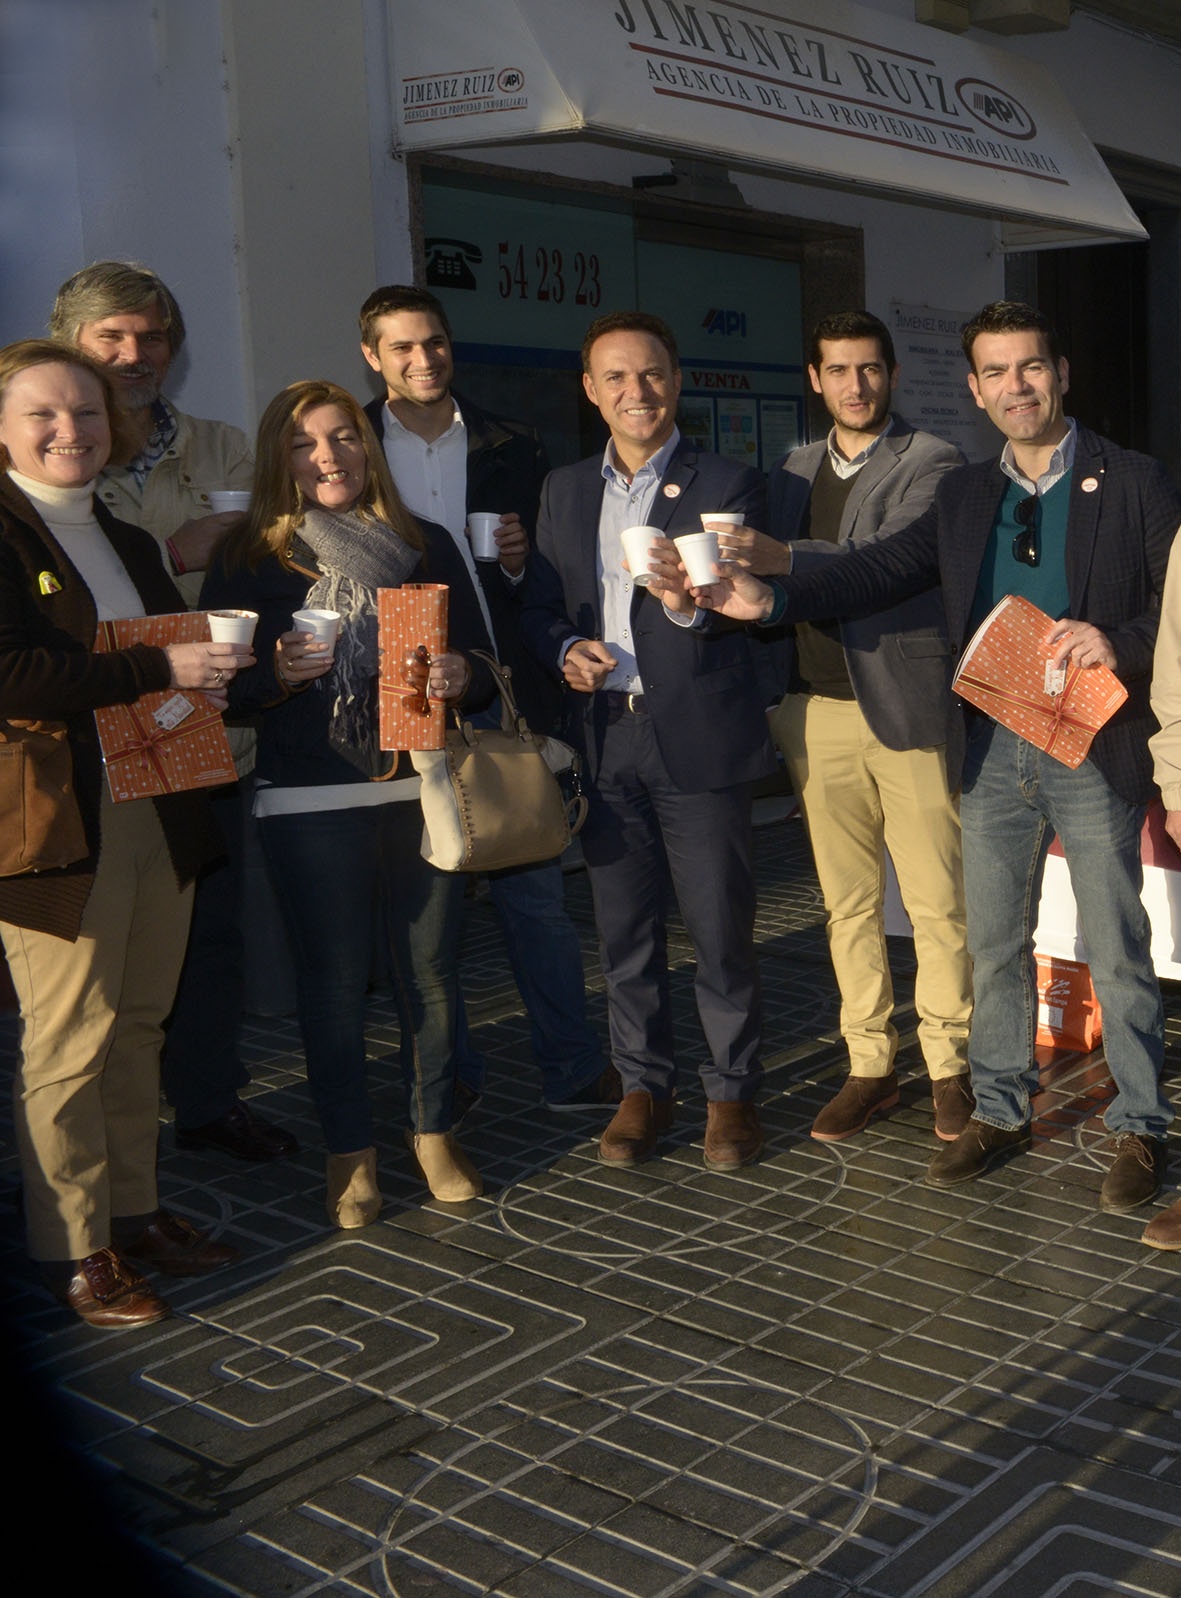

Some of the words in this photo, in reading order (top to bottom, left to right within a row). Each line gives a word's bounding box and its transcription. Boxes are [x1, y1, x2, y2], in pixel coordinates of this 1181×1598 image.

[615, 0, 842, 86] JIMENEZ
[848, 50, 959, 117] RUIZ
[403, 79, 458, 105] JIMENEZ
[463, 73, 495, 96] RUIZ
[504, 73, 520, 88] API
[404, 109, 430, 121] AGENCIA
[430, 107, 439, 117] DE
[439, 106, 448, 116] LA
[448, 101, 481, 115] PROPIEDAD
[483, 96, 528, 110] INMOBILIARIA
[646, 58, 752, 102] AGENCIA
[755, 84, 787, 111] DE
[794, 94, 825, 120] LA
[828, 103, 938, 146] PROPIEDAD
[941, 130, 1062, 175] INMOBILIARIA
[982, 94, 1025, 128] API
[498, 239, 528, 300] 54
[535, 247, 566, 305] 23
[574, 251, 601, 309] 23
[706, 309, 747, 338] API
[895, 313, 936, 331] JIMENEZ
[937, 319, 958, 335] RUIZ
[690, 371, 752, 391] VENTA
